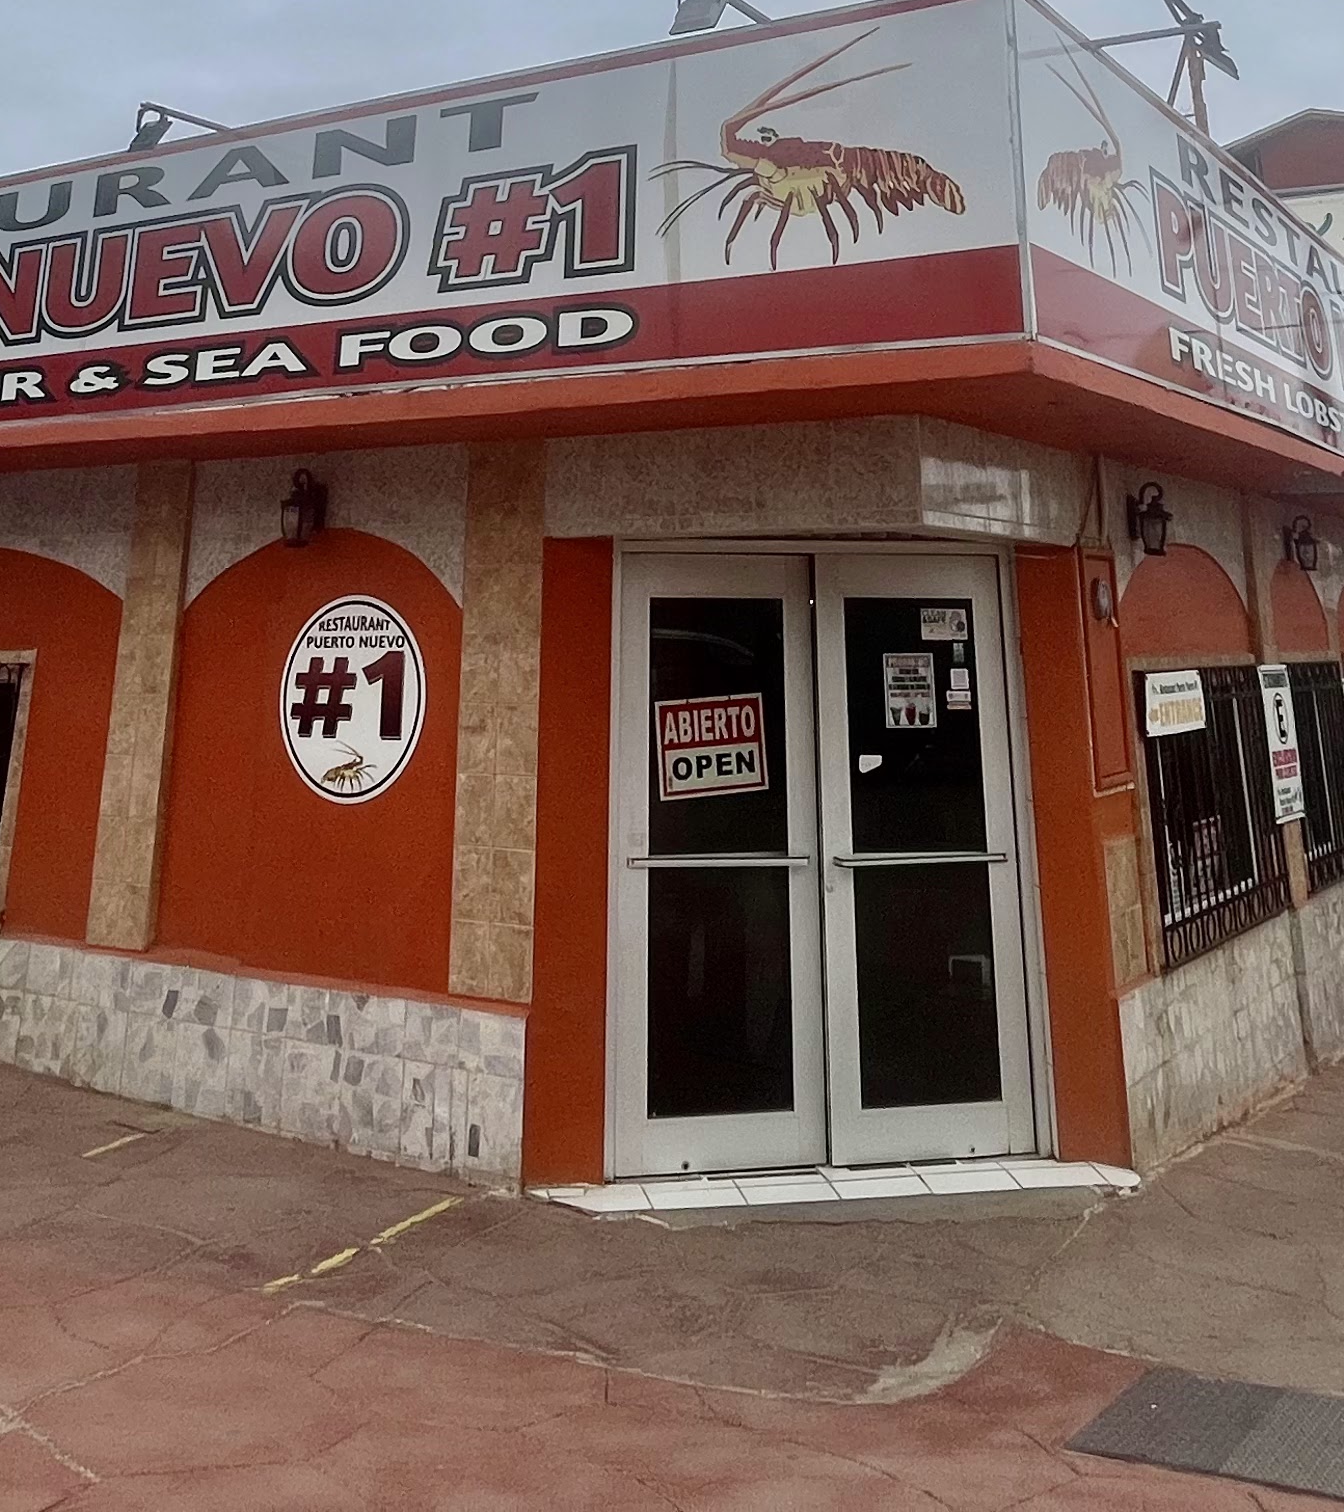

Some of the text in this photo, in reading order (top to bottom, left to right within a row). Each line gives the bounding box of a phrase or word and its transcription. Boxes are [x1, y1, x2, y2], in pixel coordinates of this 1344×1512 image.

[427, 144, 638, 294] #1
[1149, 165, 1334, 381] PUERTO
[69, 366, 121, 394] &
[143, 343, 308, 386] SEA
[339, 308, 635, 369] FOOD
[1168, 326, 1275, 403] FRESH
[306, 634, 405, 649] PUERTO NUEVO
[318, 615, 392, 633] RESTAURANT
[290, 650, 406, 741] #1
[663, 704, 756, 745] ABIERTO
[671, 749, 756, 782] OPEN
